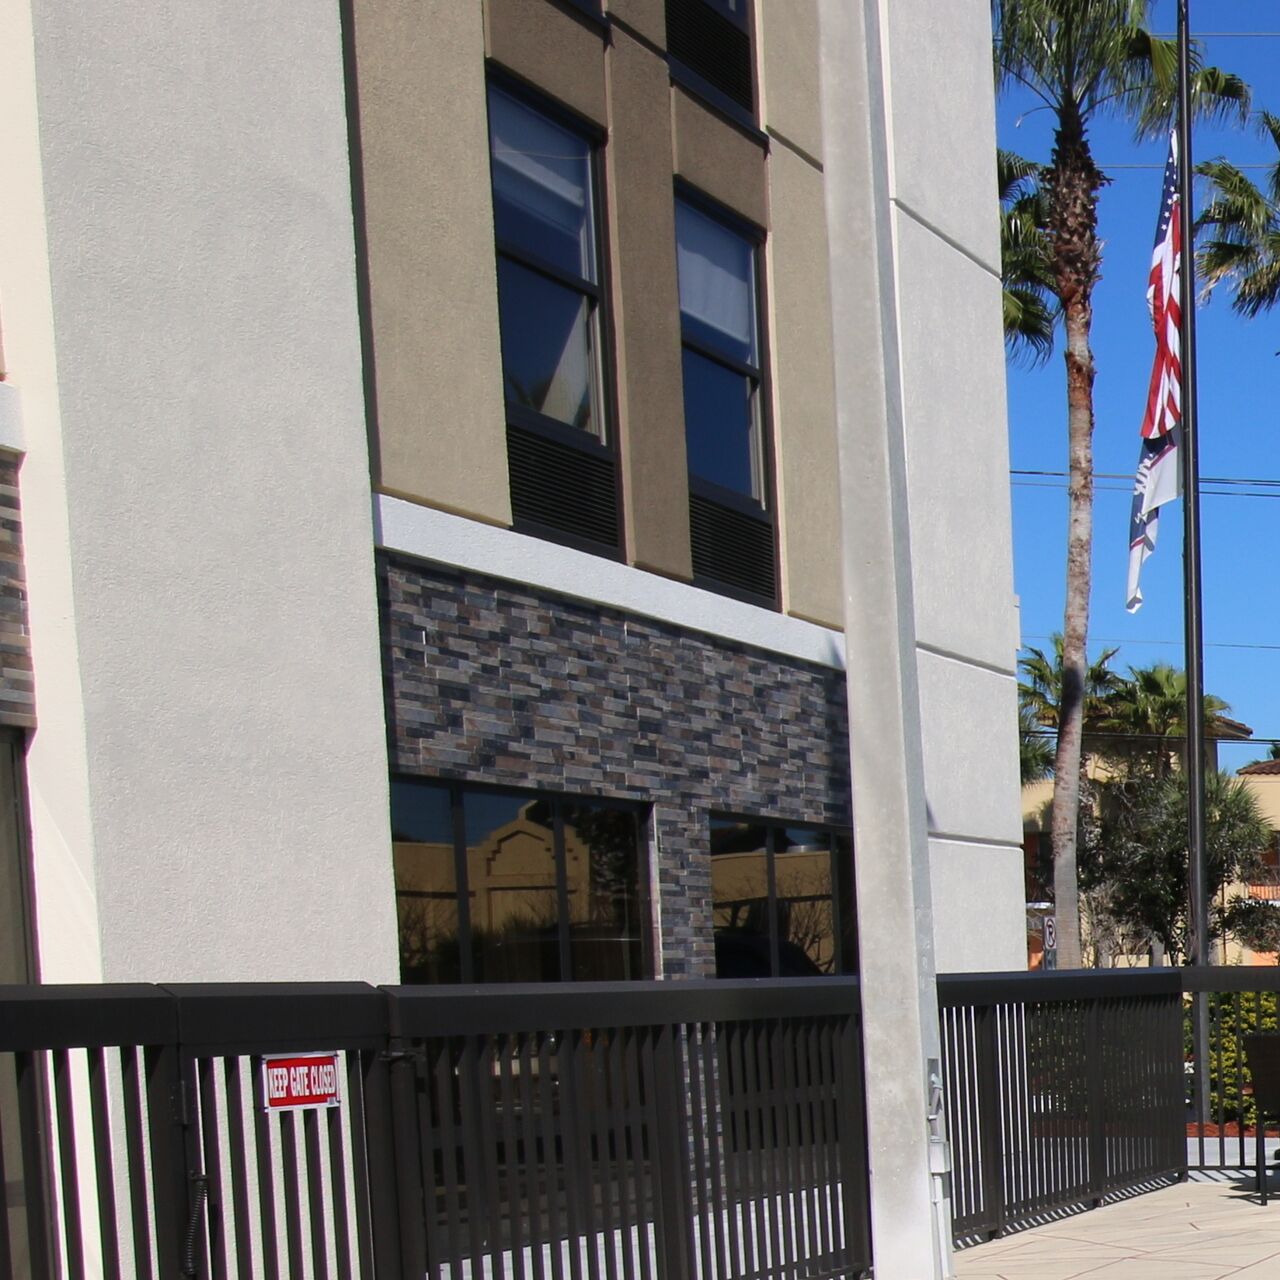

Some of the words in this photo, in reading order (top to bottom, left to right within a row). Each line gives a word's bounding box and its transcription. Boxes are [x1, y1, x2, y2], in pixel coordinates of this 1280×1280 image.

[268, 1068, 289, 1098] KEEP
[290, 1066, 310, 1097] GATE
[311, 1065, 336, 1095] CLOSED
